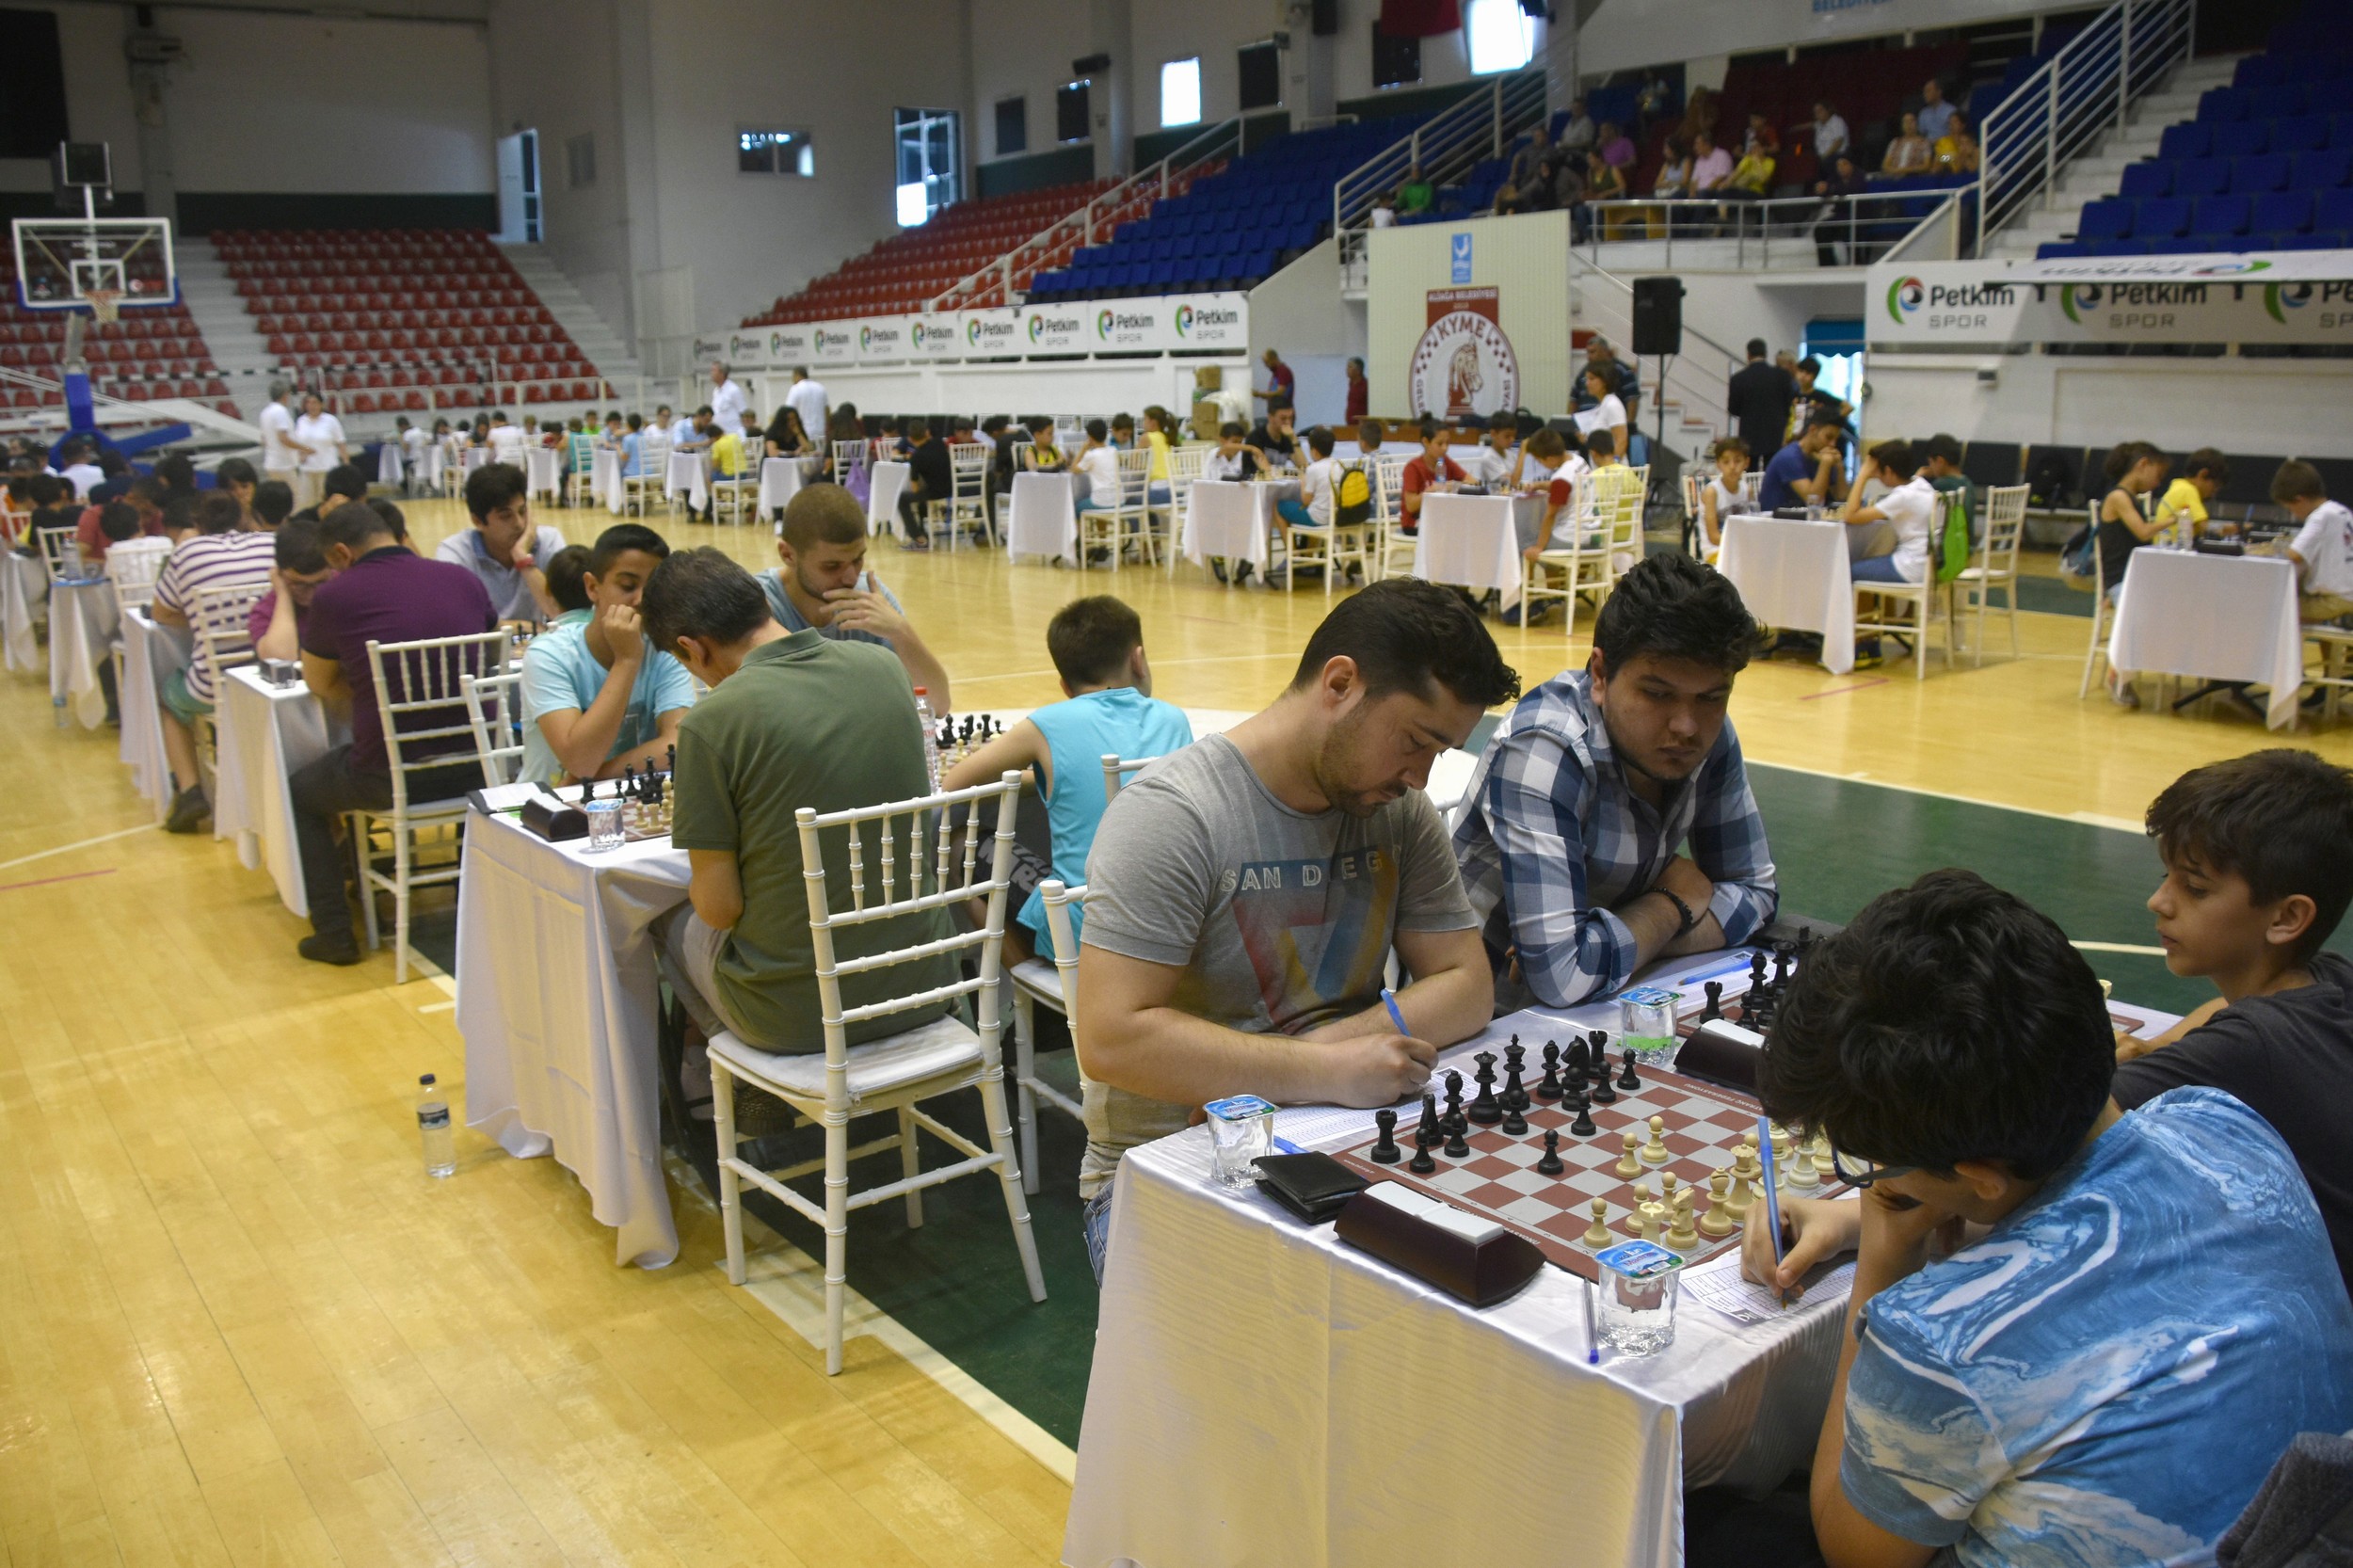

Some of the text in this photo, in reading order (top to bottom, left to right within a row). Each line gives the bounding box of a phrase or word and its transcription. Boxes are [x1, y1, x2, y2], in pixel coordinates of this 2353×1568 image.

[1930, 284, 2015, 306] Petkim
[2111, 282, 2207, 305] Petkim
[1116, 313, 1154, 329] Petkim
[1196, 309, 1238, 326] Petkim
[1930, 314, 1987, 328] SPOR
[2109, 313, 2175, 328] SPOR
[2319, 313, 2353, 328] SP
[984, 322, 1014, 336] Petkim
[1046, 318, 1080, 333] Petkim
[1436, 313, 1486, 340] KYME
[1116, 333, 1143, 343] SPOR
[1197, 330, 1225, 340] SPOR
[1220, 845, 1402, 892] SAN DEGO
[1735, 1099, 1763, 1112] ATRANÇ
